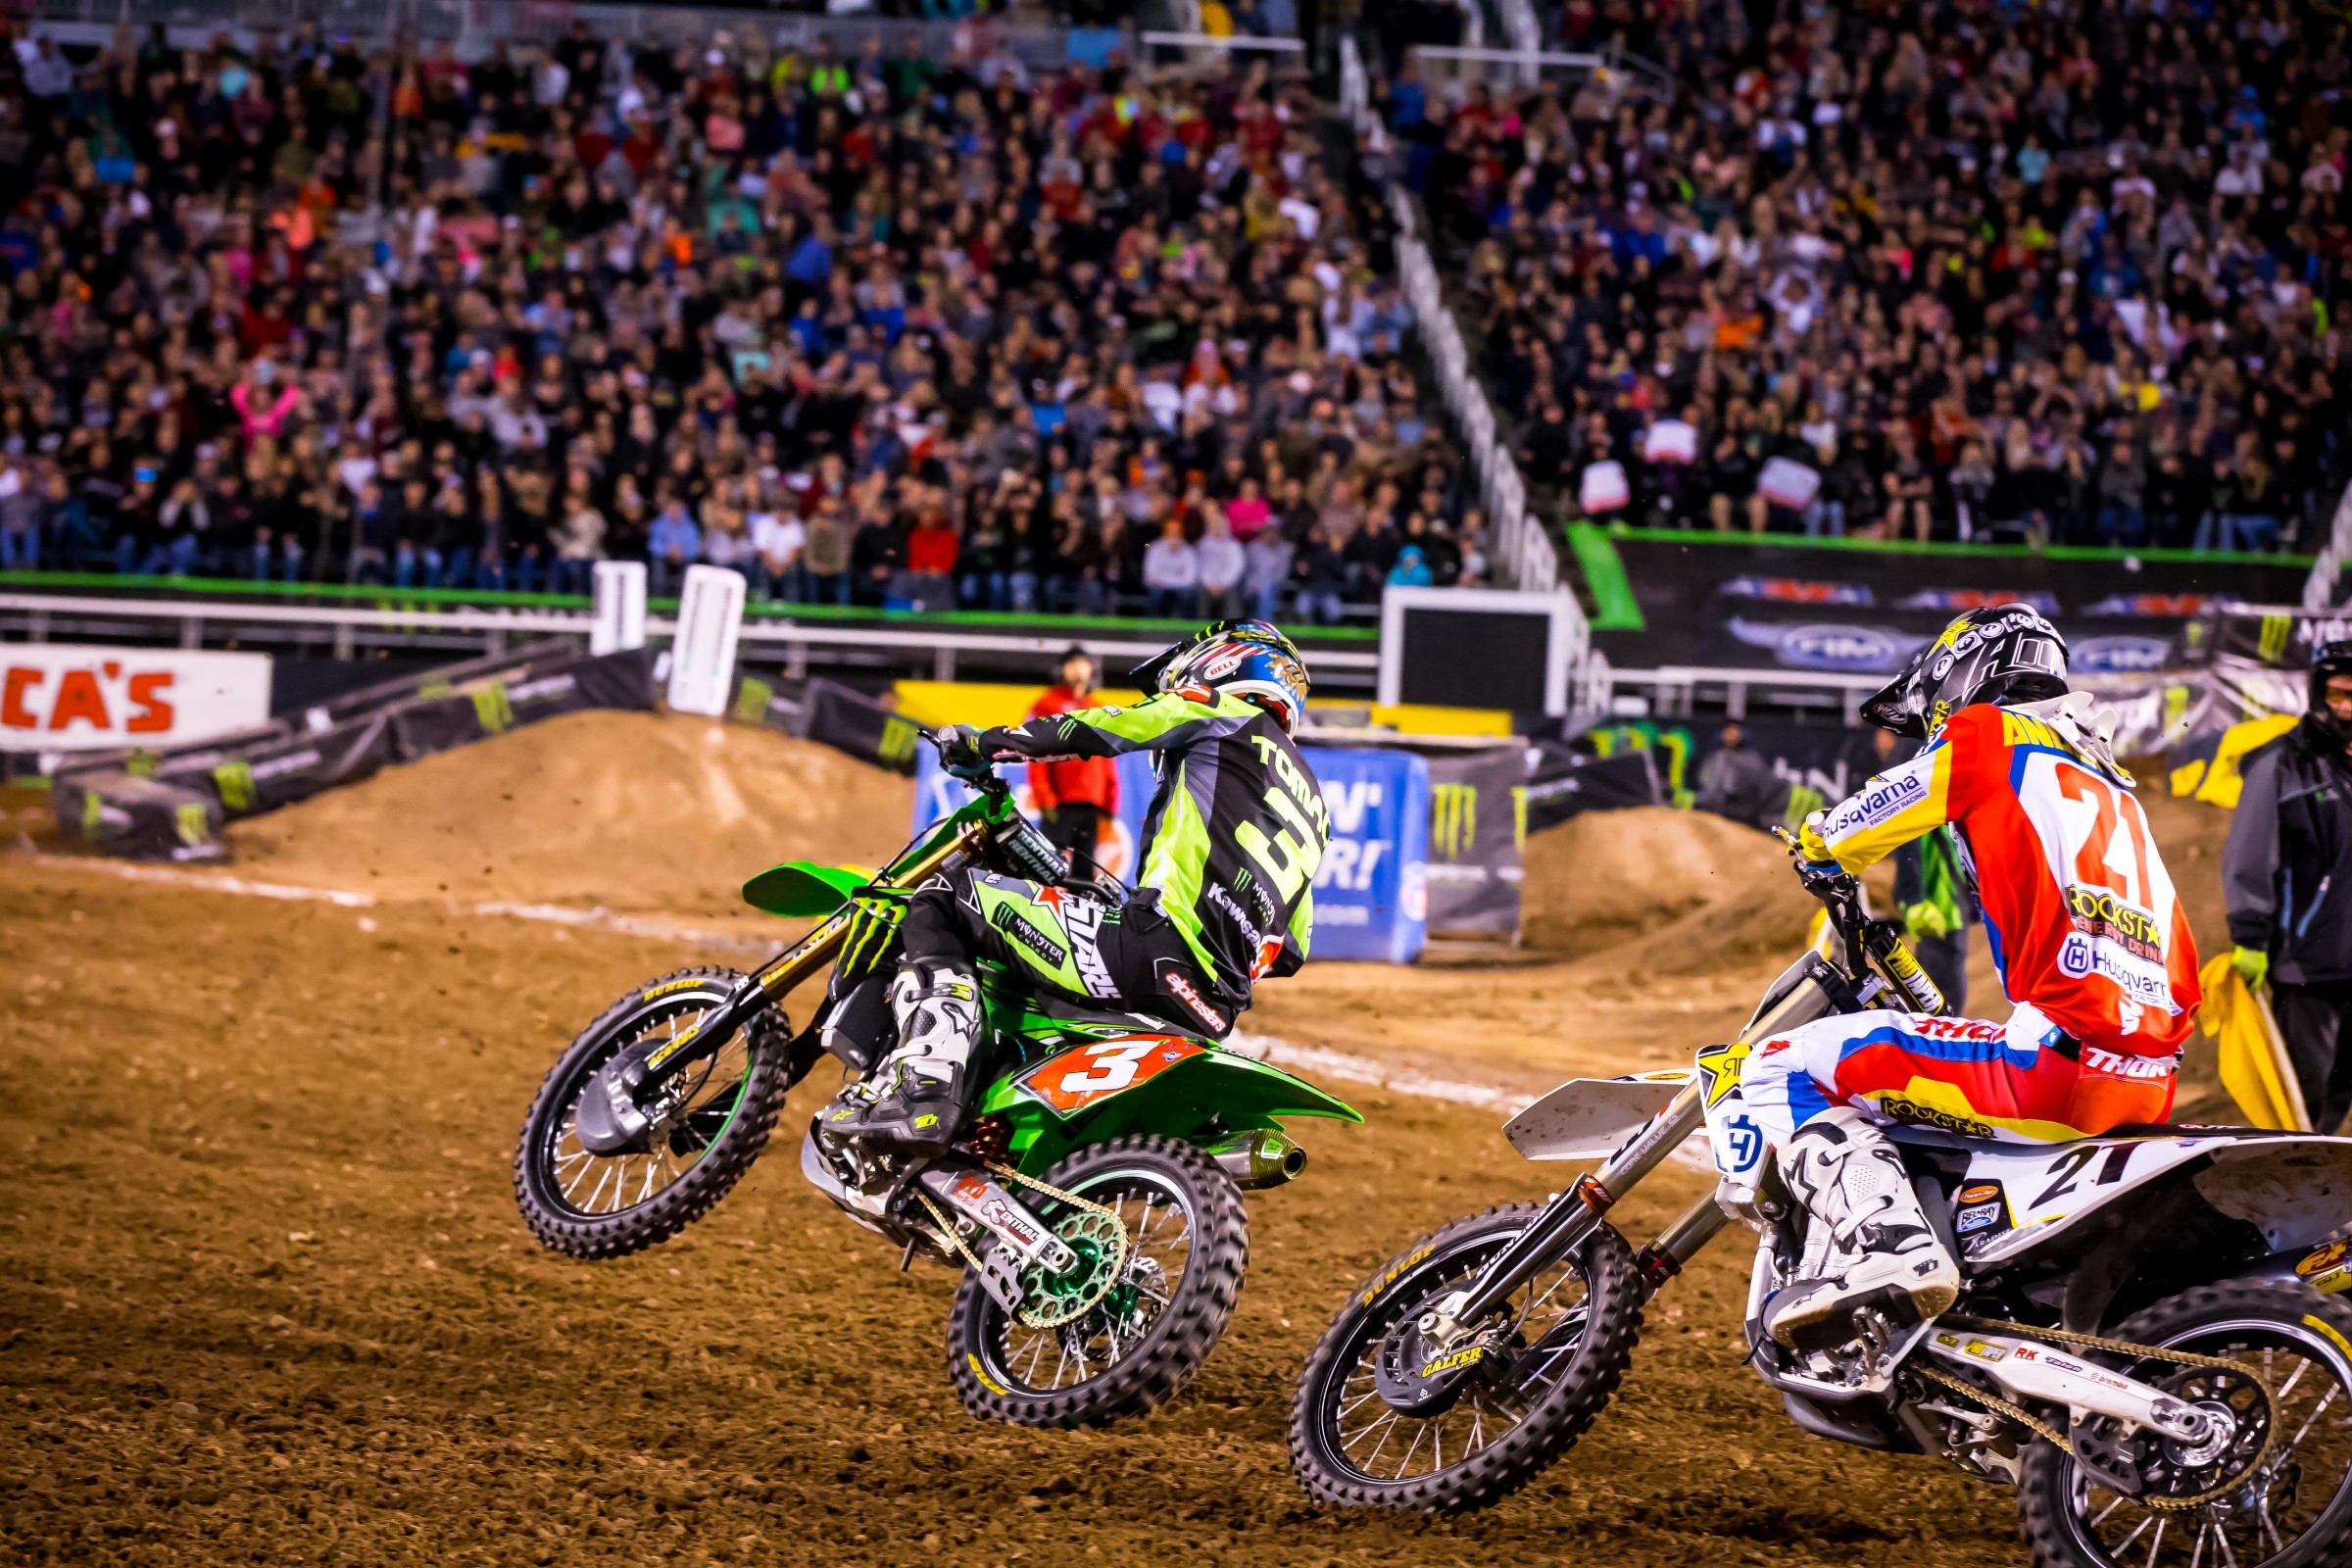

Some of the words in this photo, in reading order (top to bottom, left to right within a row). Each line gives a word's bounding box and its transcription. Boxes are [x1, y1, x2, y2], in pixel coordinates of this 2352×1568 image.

[1209, 660, 1235, 676] BELL
[1, 662, 173, 733] CA'S
[1869, 806, 1900, 826] FACTORY
[1901, 790, 1927, 808] RACING
[1017, 830, 1065, 877] RENTHAL
[1235, 787, 1322, 905] 3
[2055, 762, 2154, 913] 21
[1007, 839, 1056, 885] RENTHAL
[1015, 917, 1063, 961] MONSTER
[1017, 933, 1054, 963] ENERGY
[643, 979, 705, 1002] DUNLOP
[2092, 950, 2168, 997] Husqvar
[1165, 971, 1227, 1032] alpinestars
[1059, 1040, 1160, 1093] 3
[2028, 1141, 2144, 1210] 21
[1363, 1243, 1436, 1307] DUNLOP
[1422, 1346, 1483, 1378] GALFER
[2014, 1347, 2040, 1361] RK
